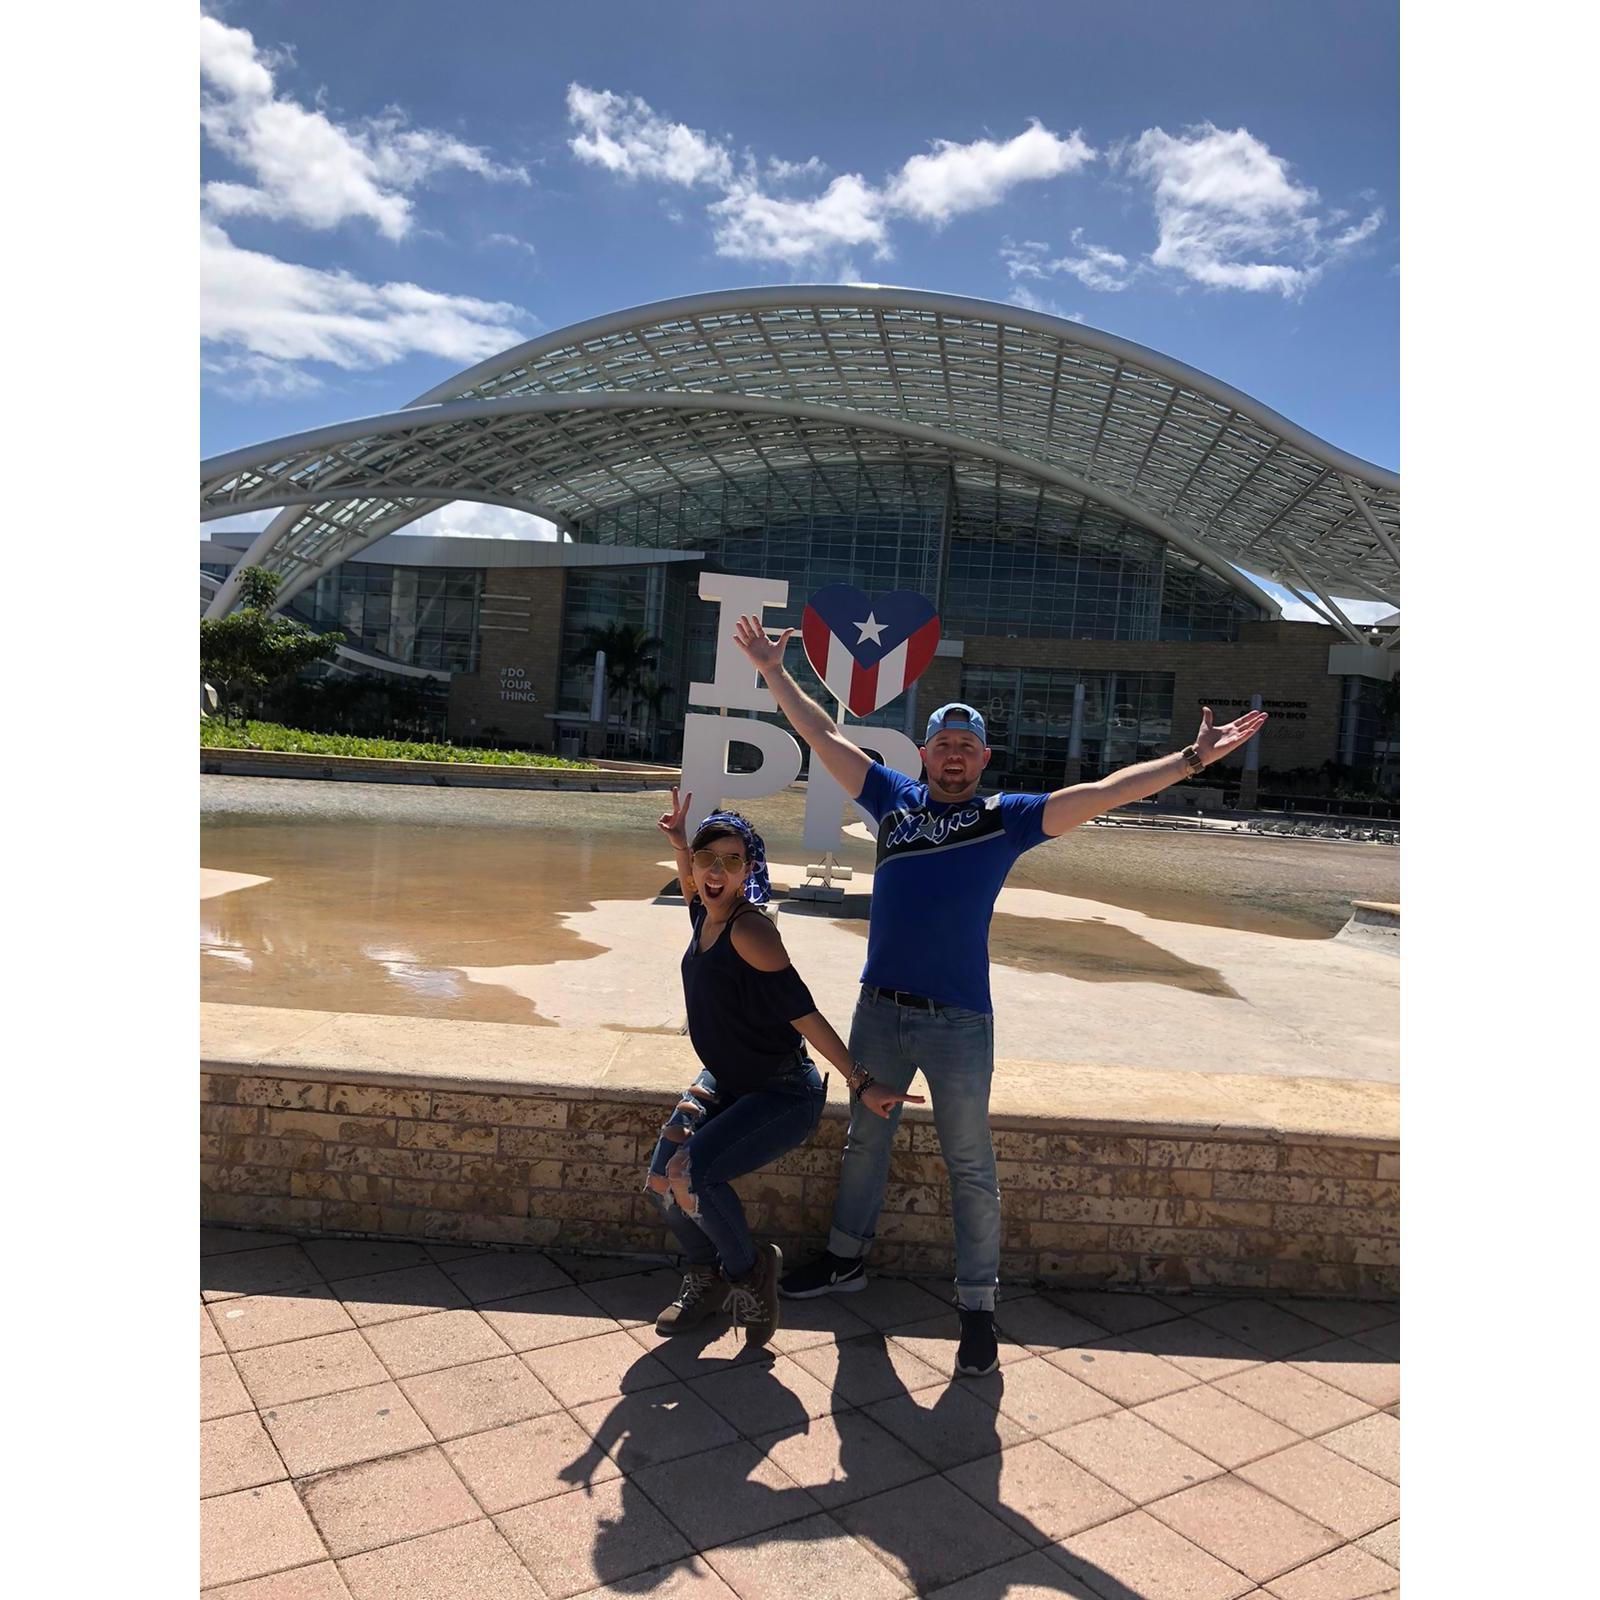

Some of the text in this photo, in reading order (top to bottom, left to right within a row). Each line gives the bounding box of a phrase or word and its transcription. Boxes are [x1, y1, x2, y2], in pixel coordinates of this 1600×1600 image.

[689, 571, 789, 713] I
[500, 667, 525, 677] #DO
[500, 679, 531, 690] YOUR
[500, 691, 538, 703] THING.
[1198, 698, 1230, 706] CENTRO
[1231, 699, 1243, 707] DE
[1286, 712, 1307, 721] RICO
